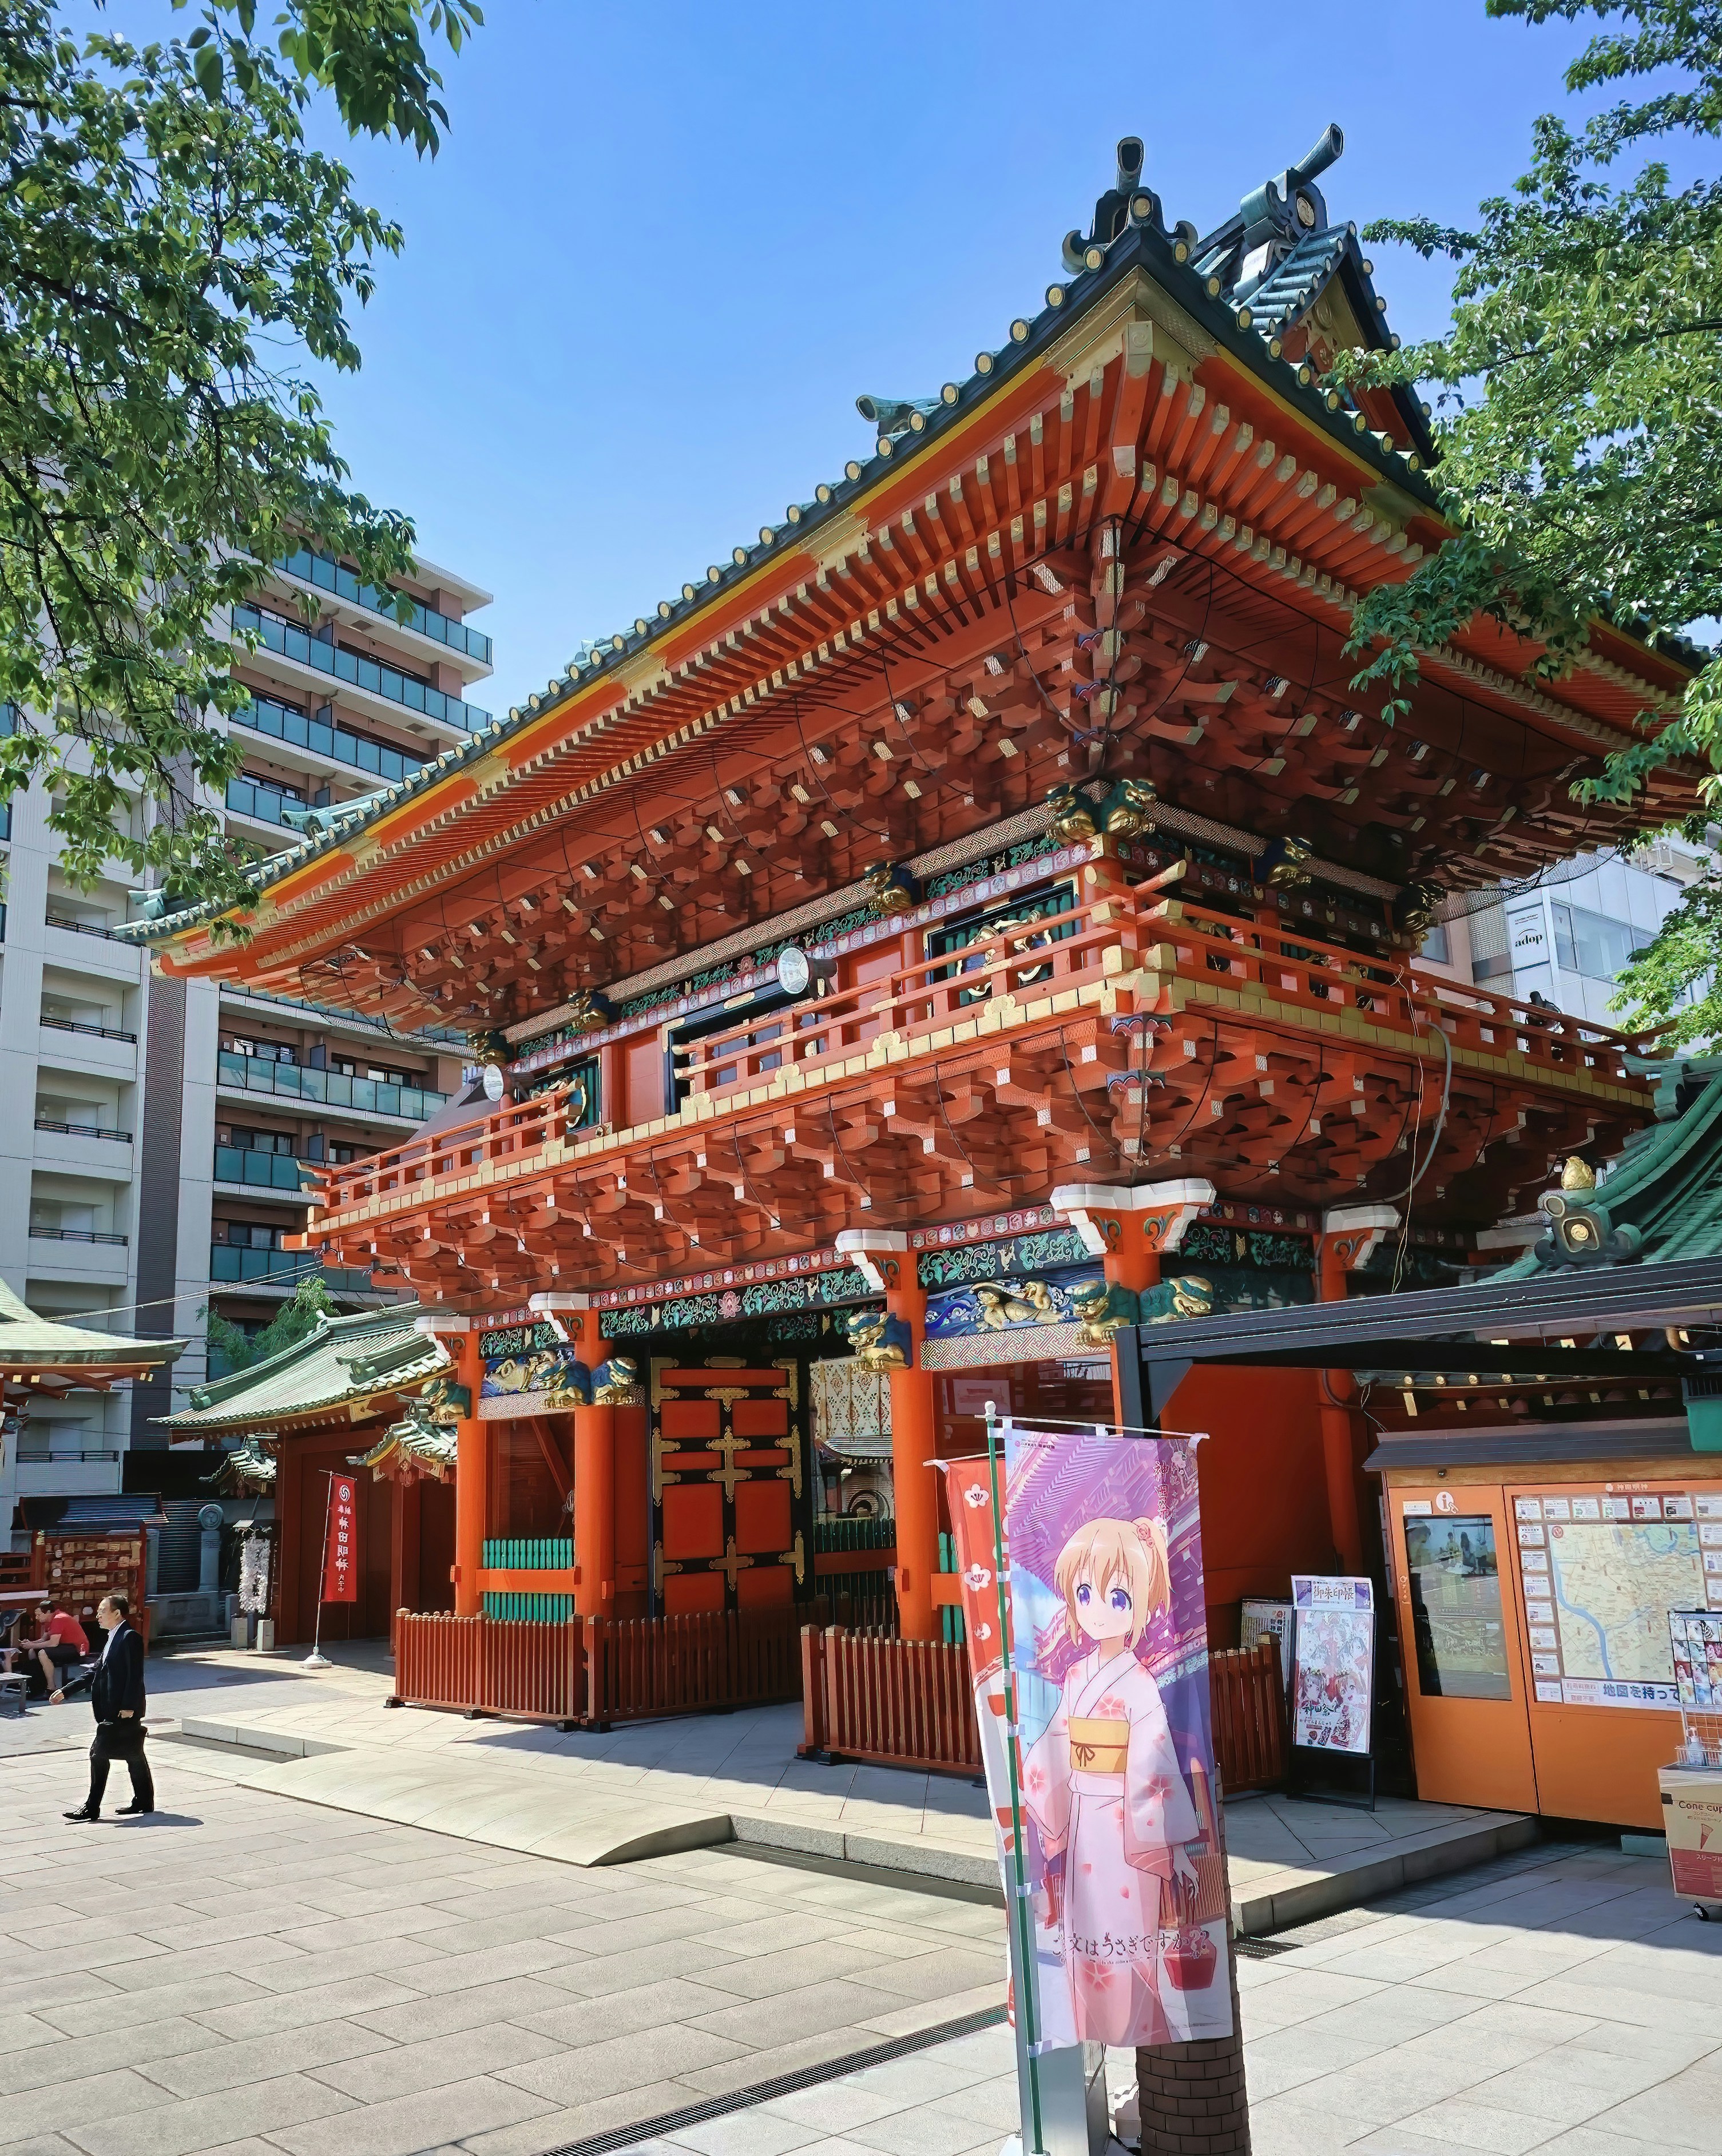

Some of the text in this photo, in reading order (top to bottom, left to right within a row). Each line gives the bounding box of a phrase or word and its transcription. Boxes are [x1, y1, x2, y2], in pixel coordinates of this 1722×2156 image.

[1515, 935, 1542, 947] adop
[1313, 1585, 1354, 1600] 御朱印帳
[1679, 1801, 1703, 1810] Cone
[1053, 1929, 1209, 1958] ご文はうさぎですか??
